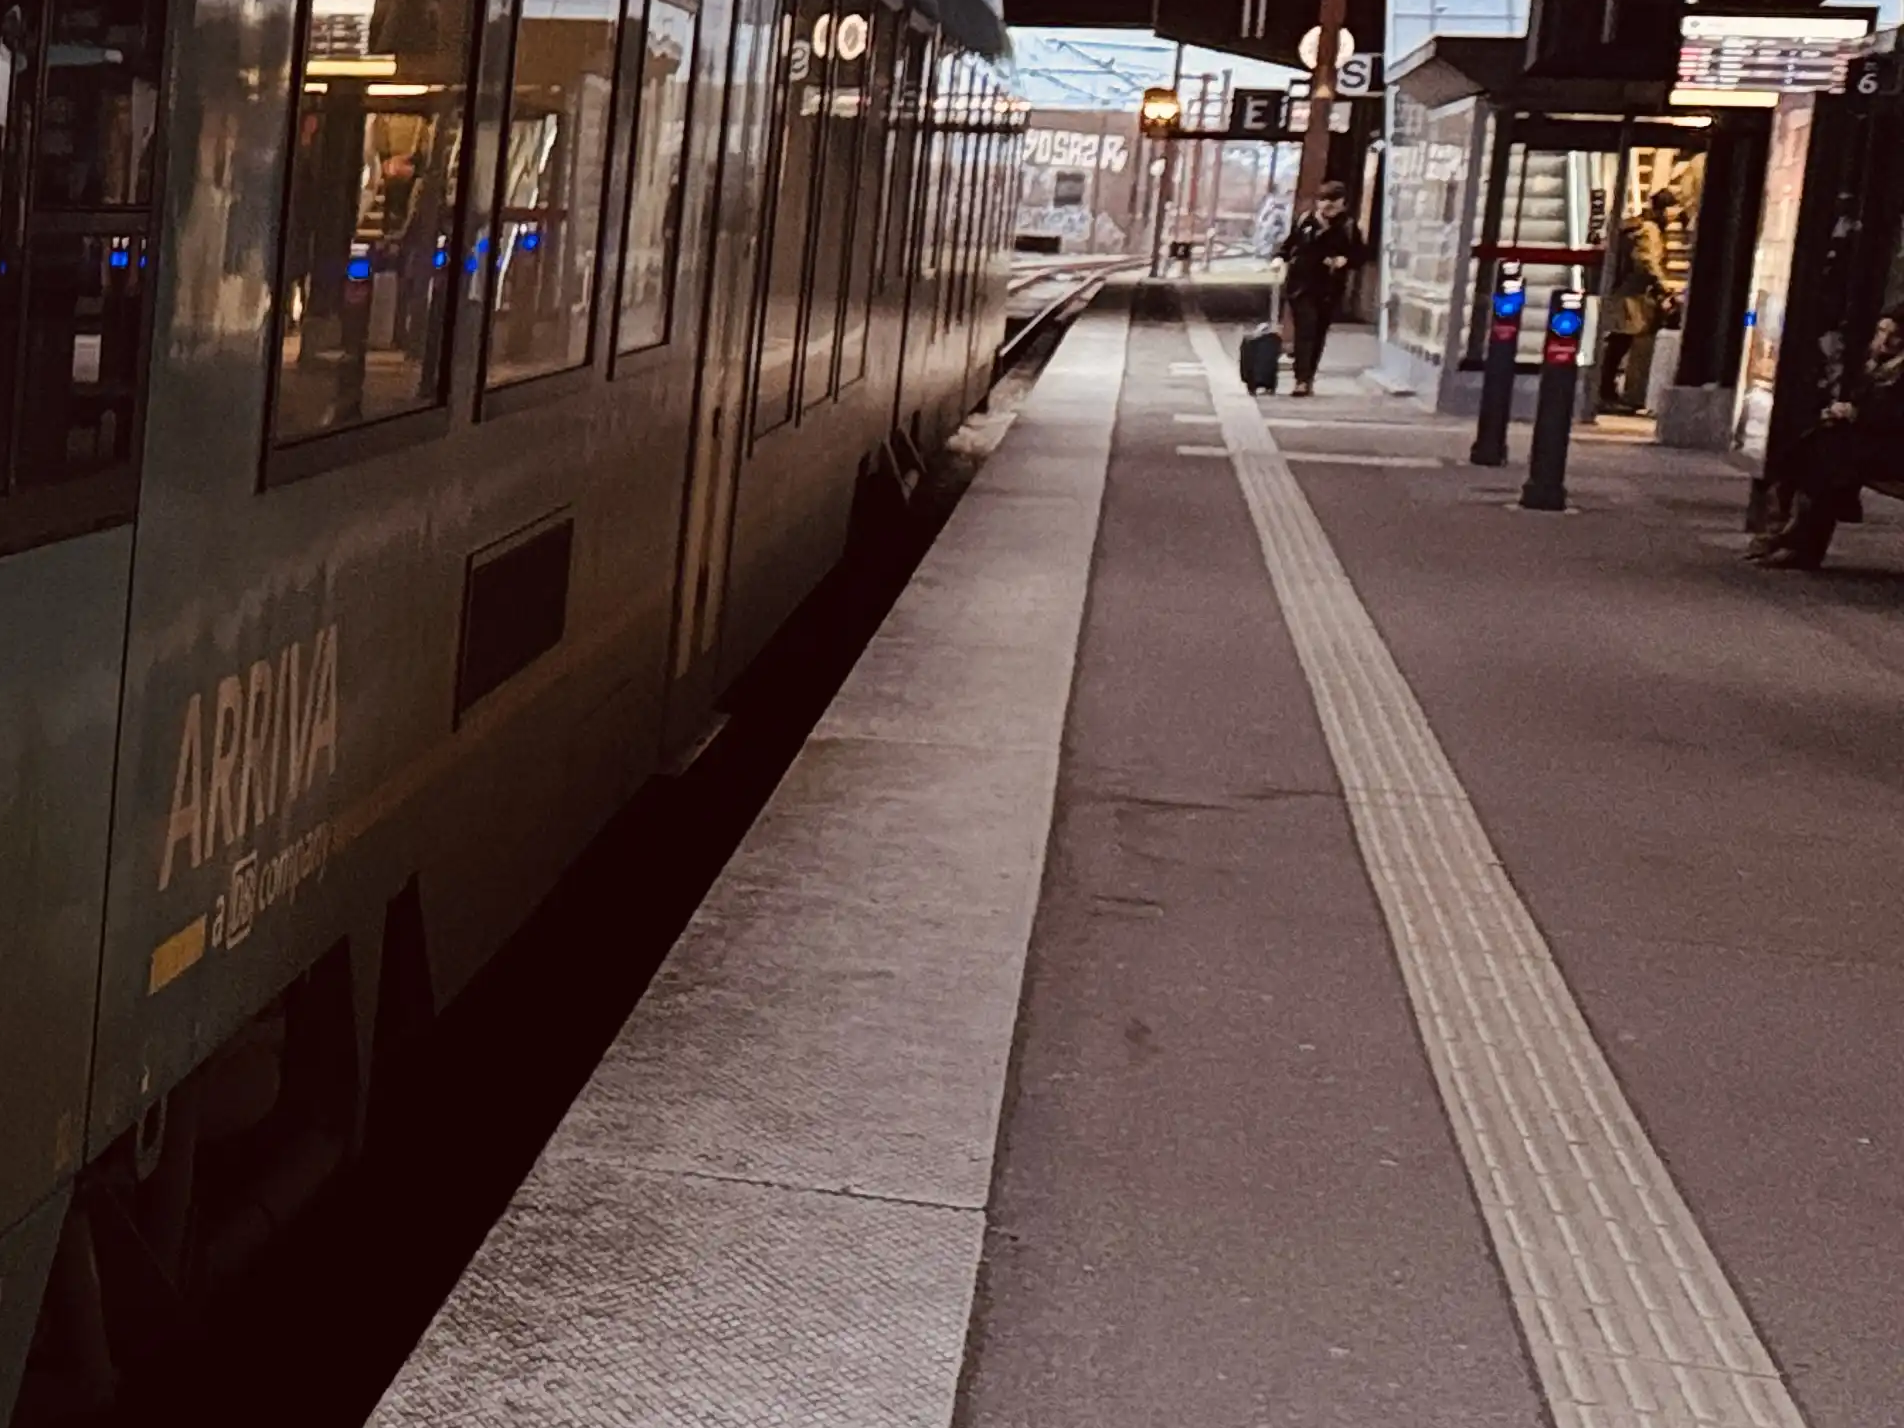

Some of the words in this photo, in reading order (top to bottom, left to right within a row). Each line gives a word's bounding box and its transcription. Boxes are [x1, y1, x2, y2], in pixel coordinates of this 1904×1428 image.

[1340, 59, 1367, 89] S
[1858, 73, 1879, 94] 6
[1244, 96, 1269, 131] E
[158, 623, 338, 891] ARRIVA
[211, 894, 225, 948] a
